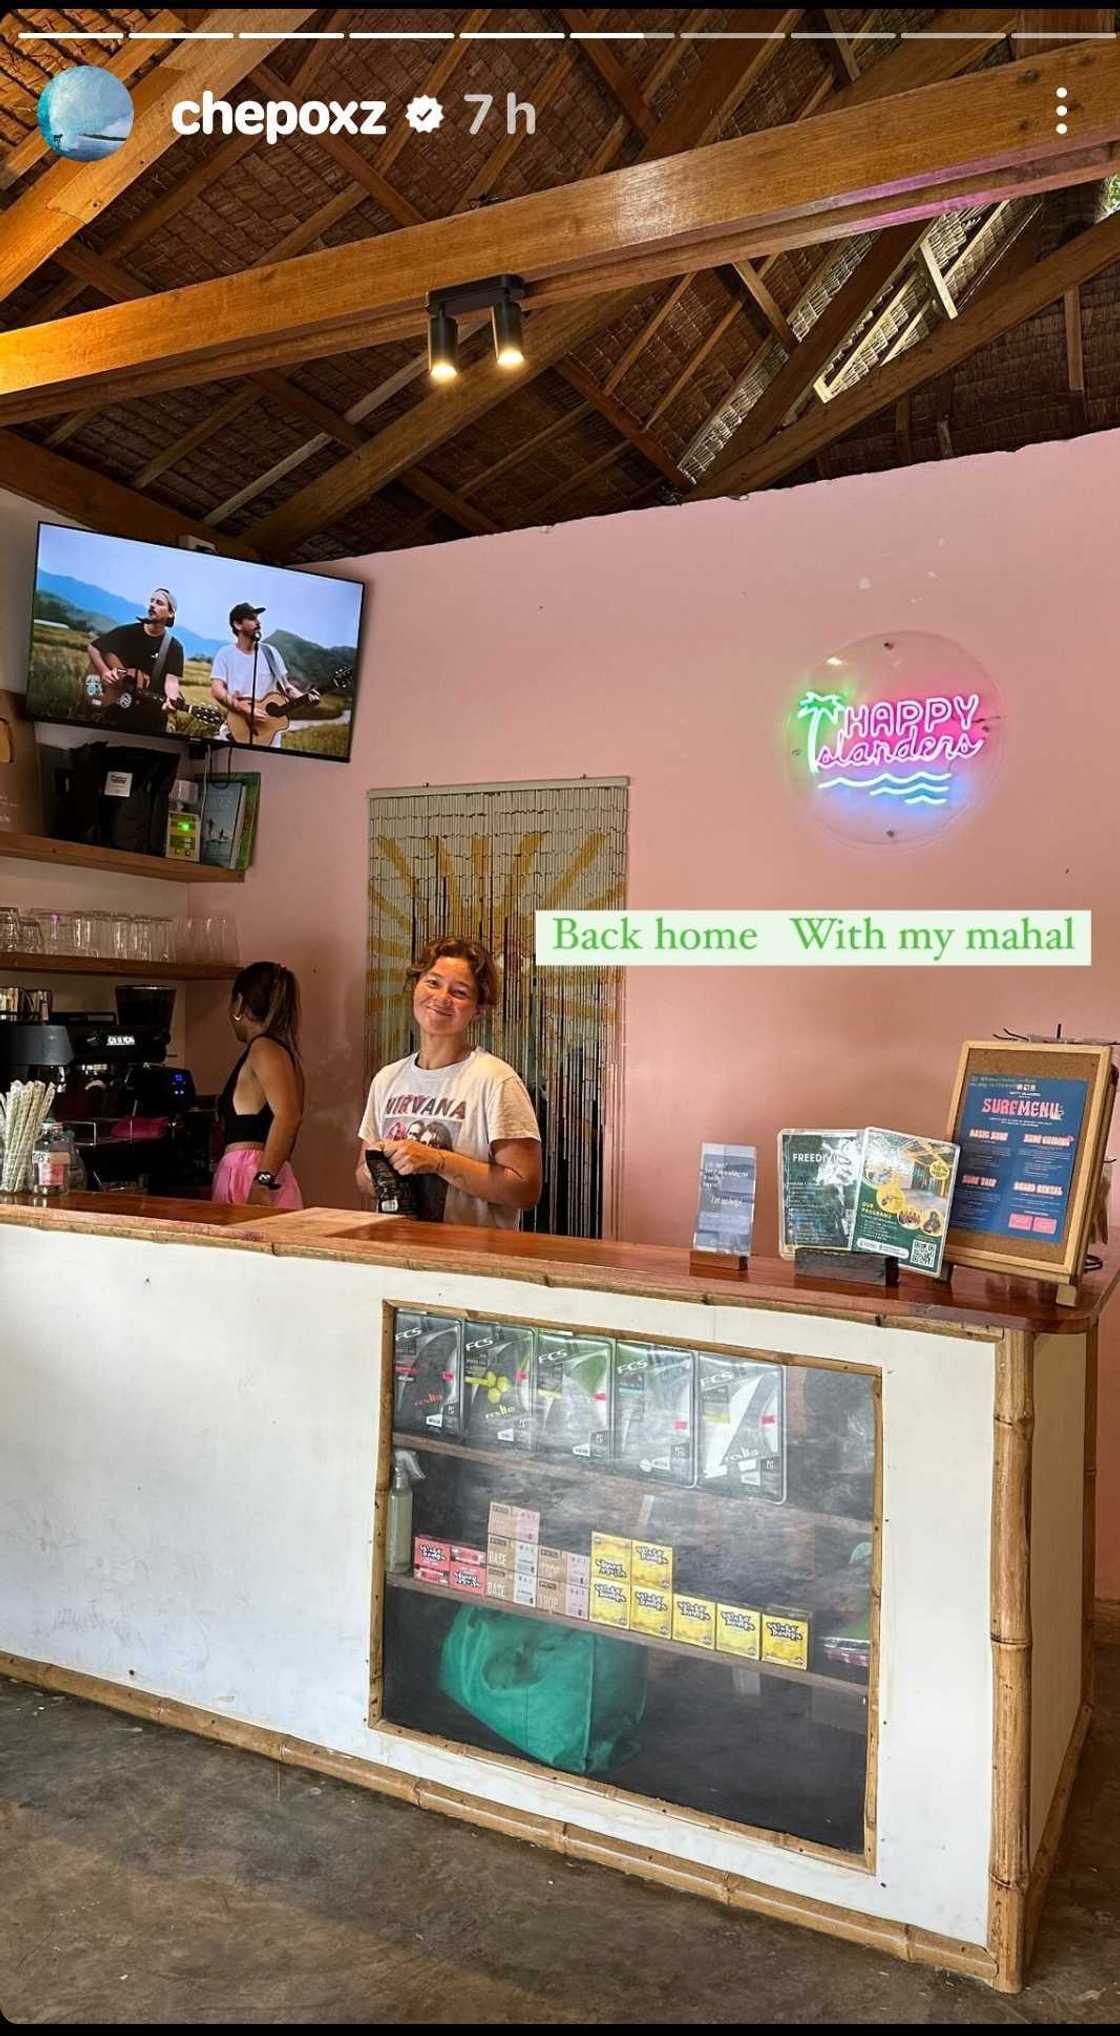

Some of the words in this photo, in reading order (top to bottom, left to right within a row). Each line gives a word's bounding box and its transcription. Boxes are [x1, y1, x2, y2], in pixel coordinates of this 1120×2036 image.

[845, 694, 979, 738] HAPPY
[384, 1094, 467, 1120] NIRVANA
[395, 1327, 423, 1341] FCS
[465, 1337, 494, 1351] FCS
[538, 1349, 568, 1363] FCS
[617, 1359, 648, 1374] FCS
[700, 1370, 735, 1387] FCS
